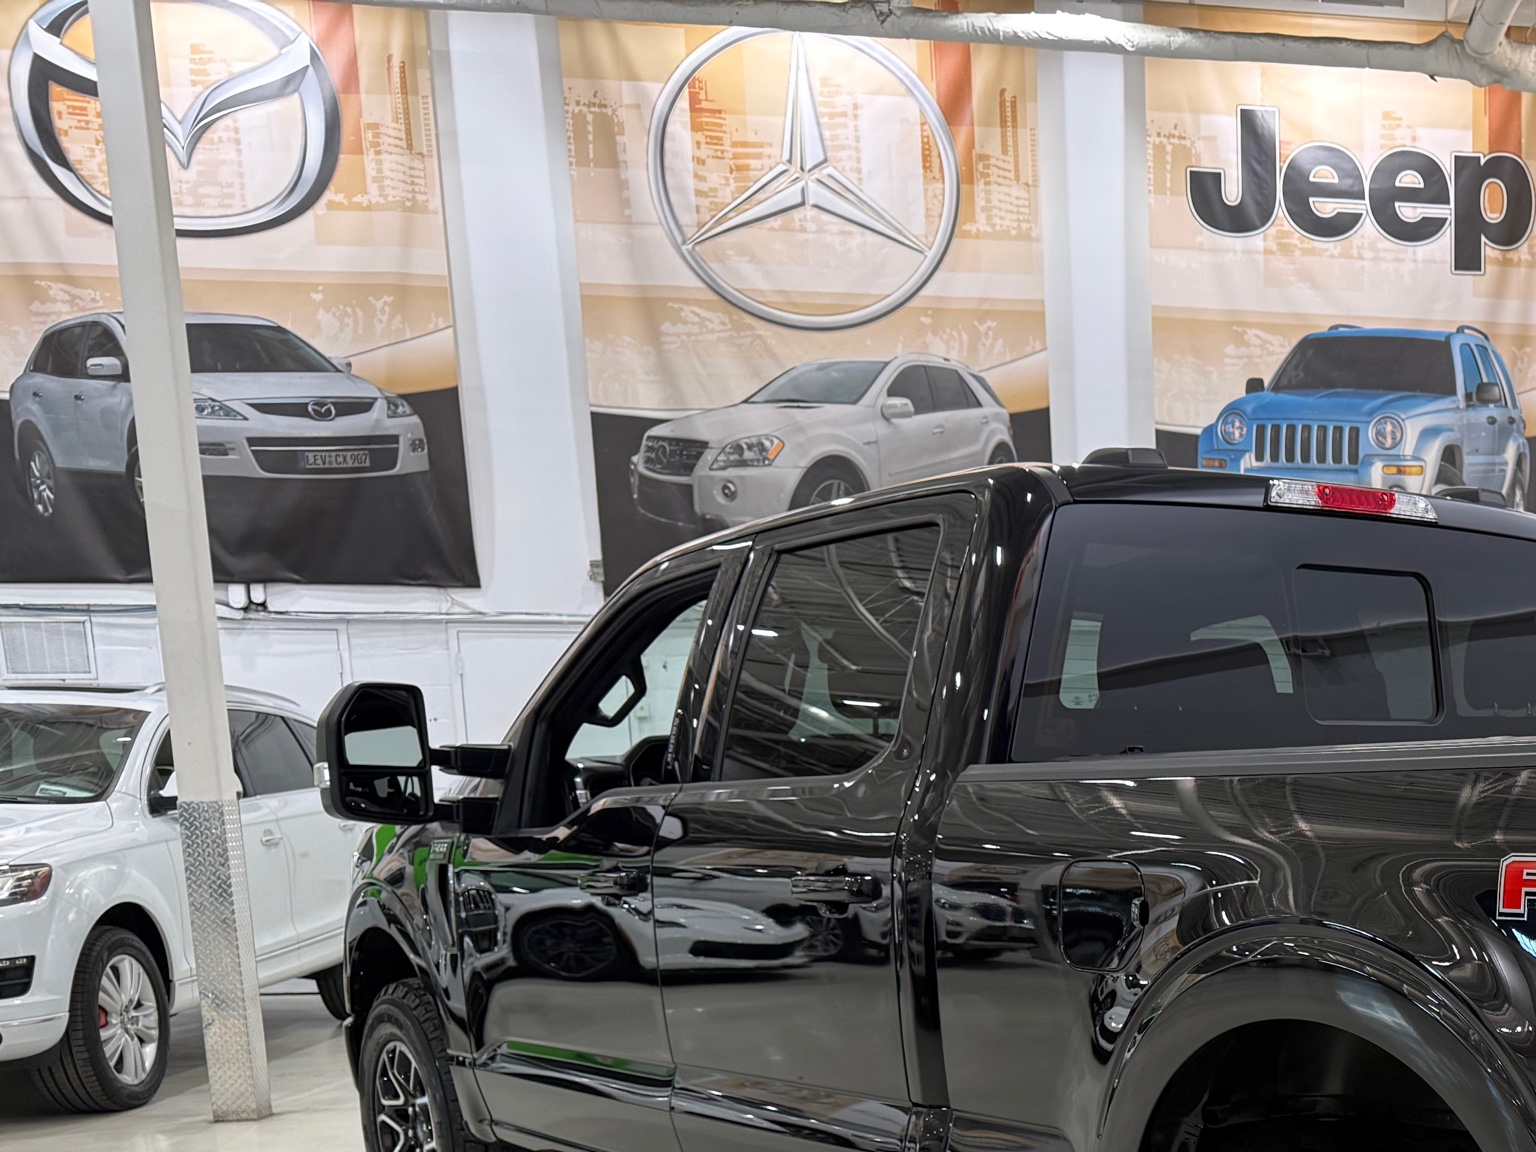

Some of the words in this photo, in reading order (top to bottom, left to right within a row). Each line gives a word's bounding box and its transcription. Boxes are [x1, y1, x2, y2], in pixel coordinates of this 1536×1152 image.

[1186, 103, 1536, 276] Jeep
[306, 454, 327, 466] LEV
[334, 453, 348, 466] CX
